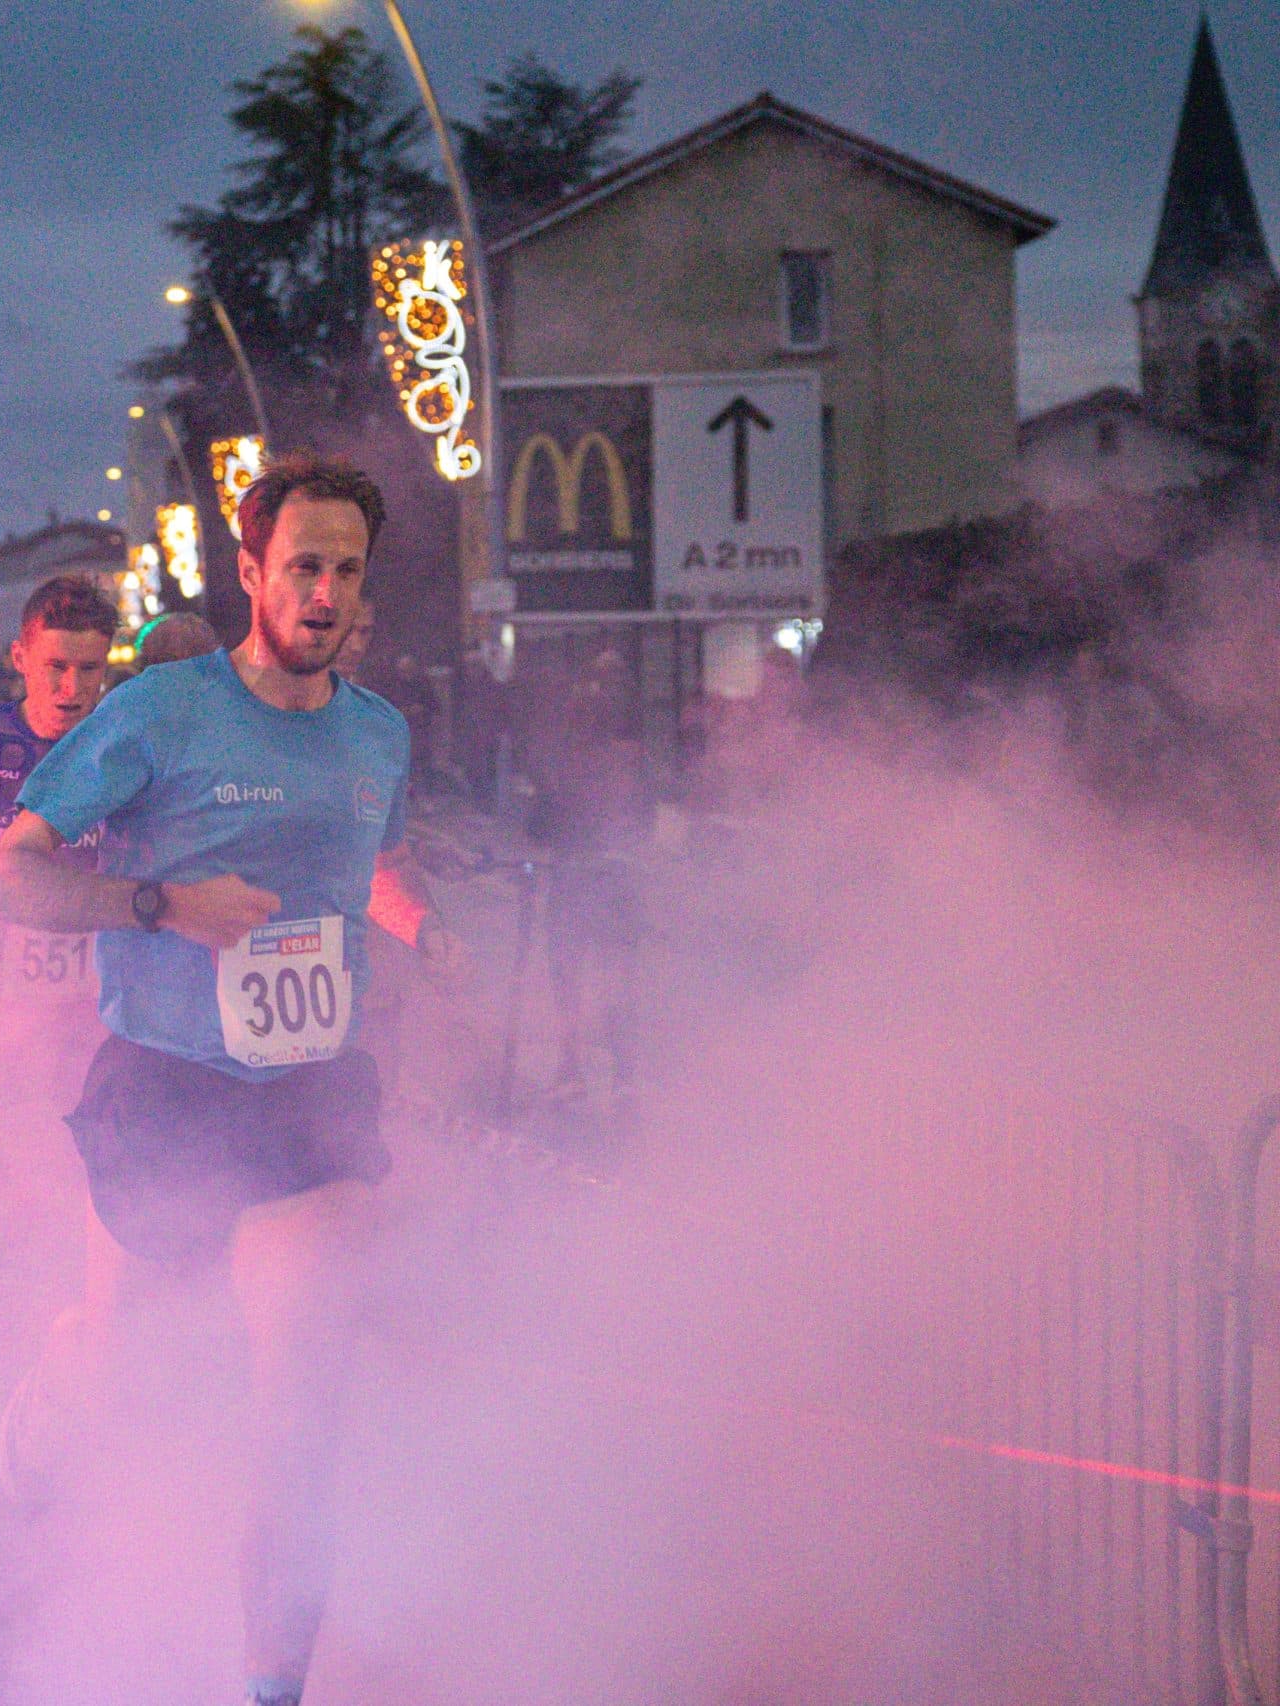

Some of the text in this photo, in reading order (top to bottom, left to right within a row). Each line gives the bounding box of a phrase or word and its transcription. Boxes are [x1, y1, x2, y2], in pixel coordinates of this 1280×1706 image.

[243, 782, 284, 802] i-run
[21, 935, 88, 984] 551
[240, 963, 337, 1038] 300
